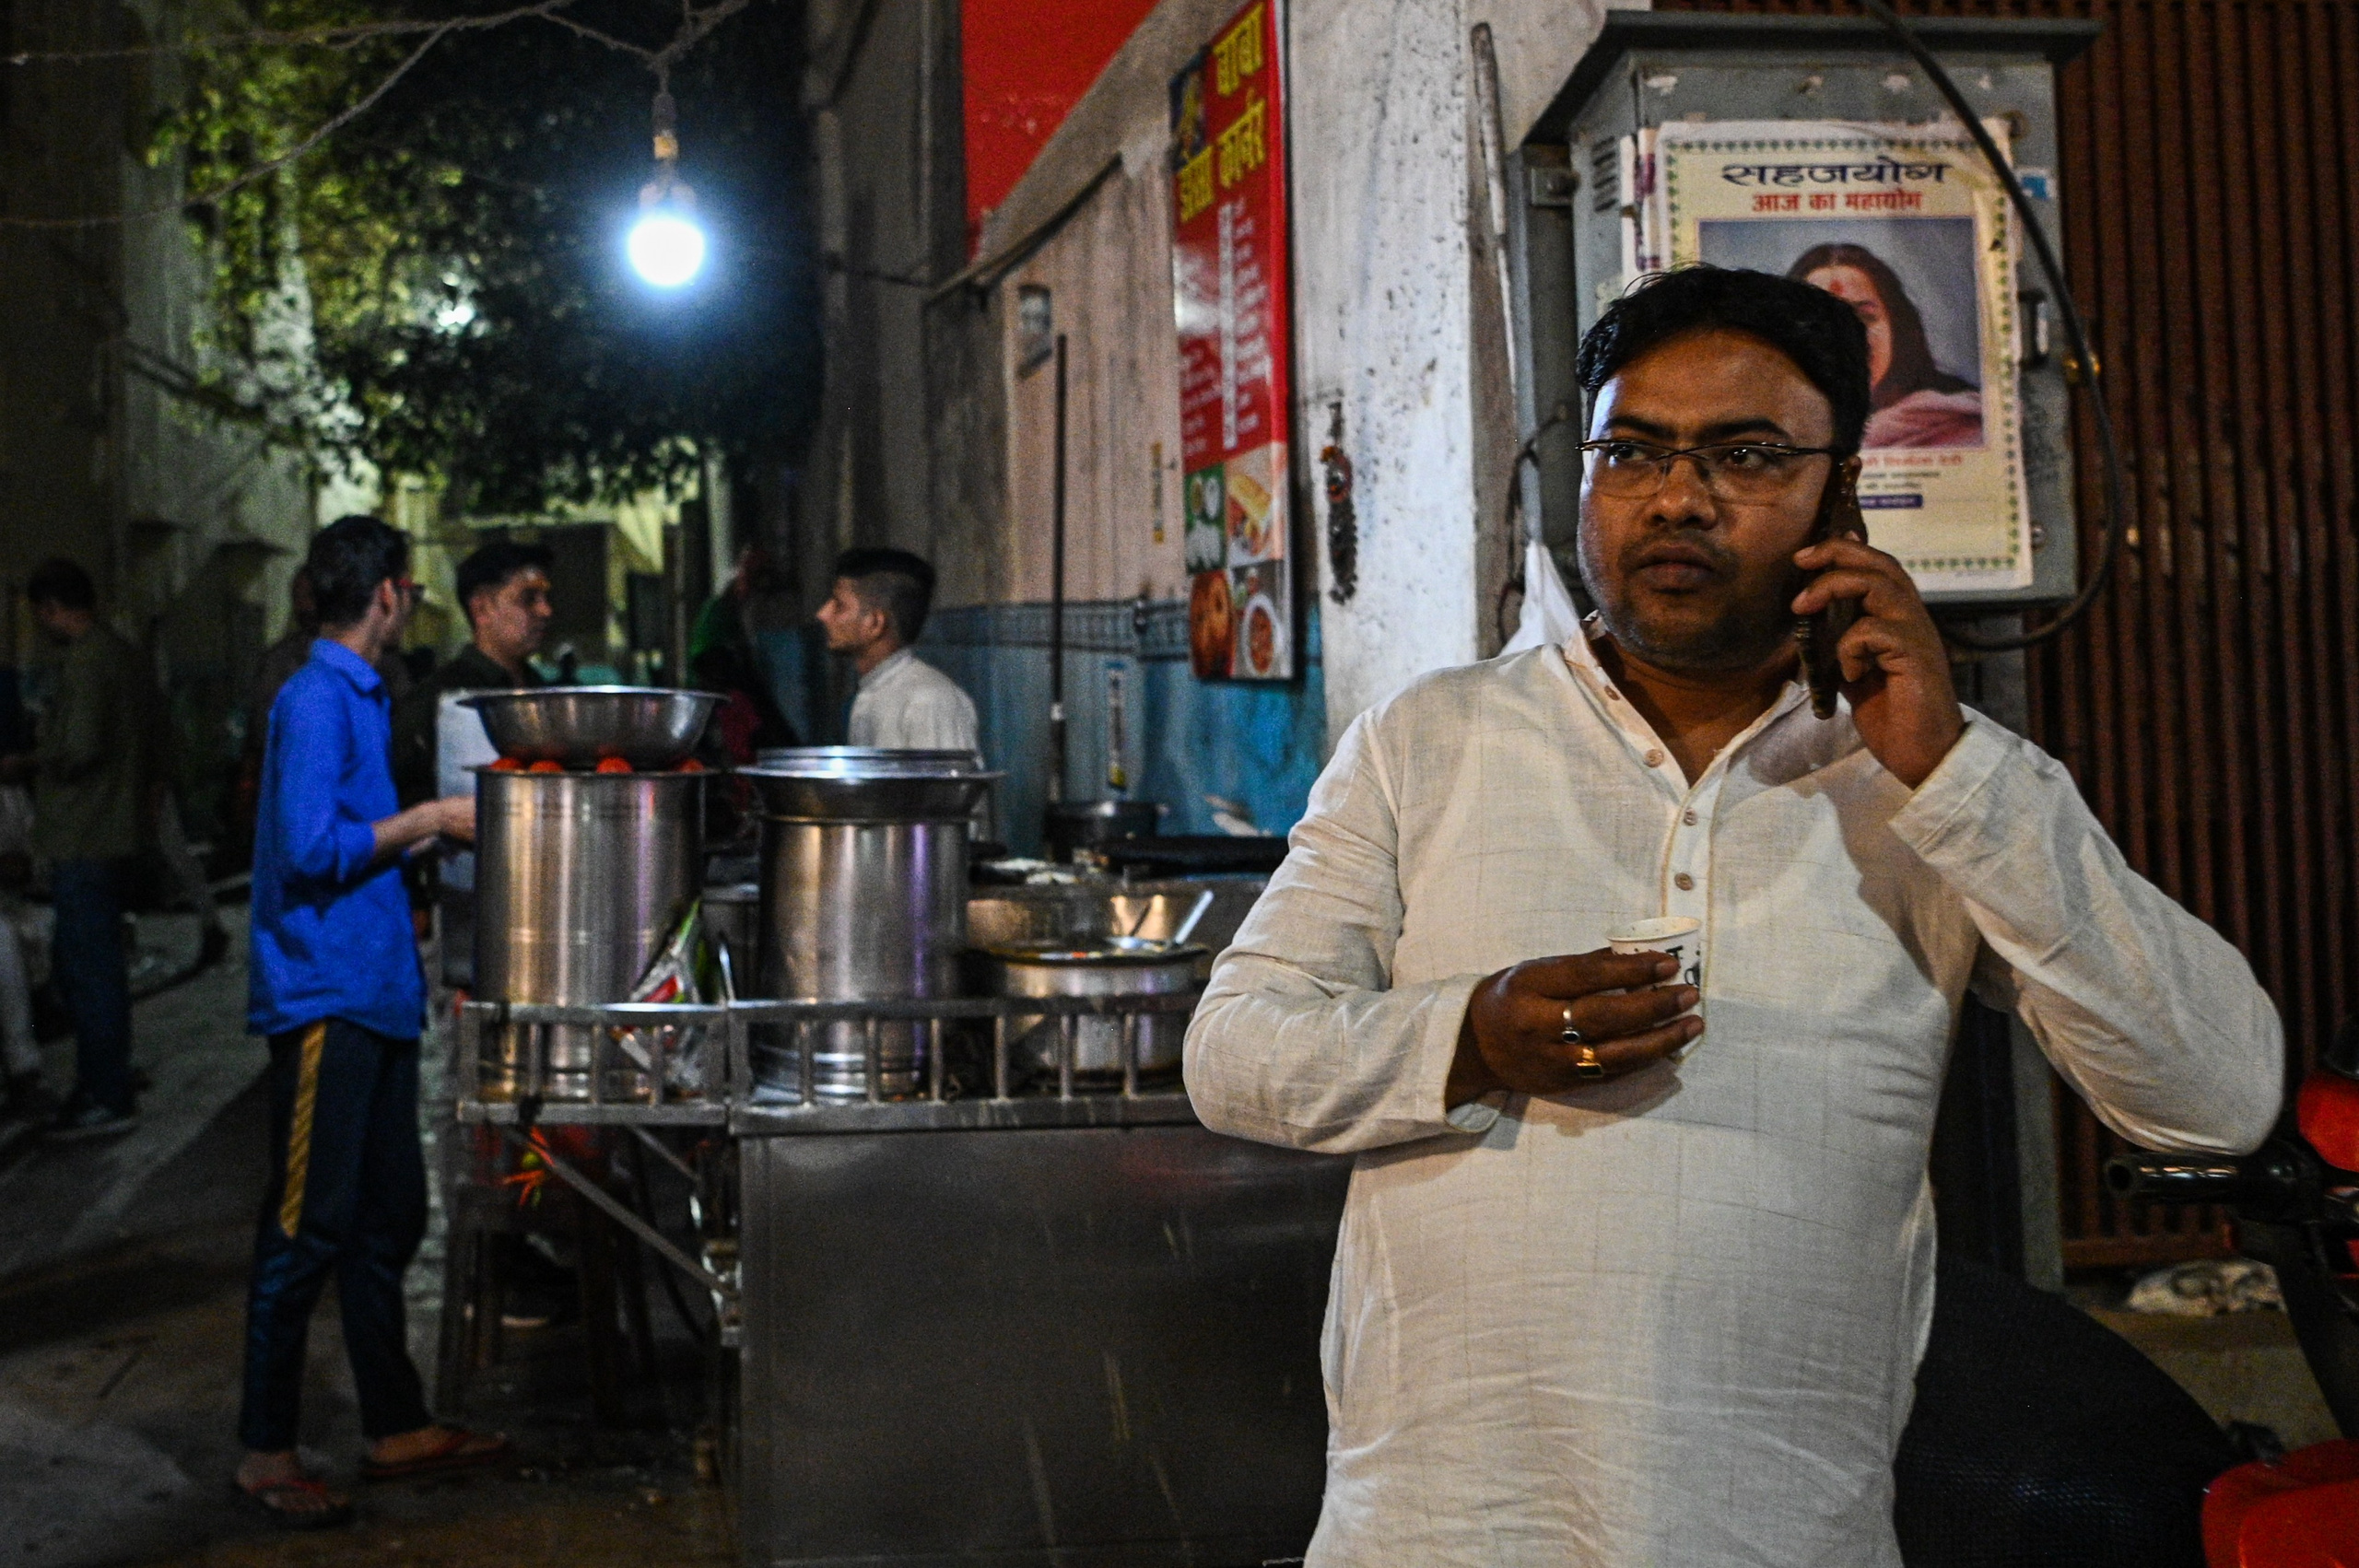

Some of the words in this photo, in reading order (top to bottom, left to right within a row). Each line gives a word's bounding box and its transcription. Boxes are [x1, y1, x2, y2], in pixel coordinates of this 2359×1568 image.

[1721, 155, 1952, 186] सहजयोग
[1753, 193, 1801, 212] आज
[1809, 193, 1837, 211] का
[1845, 188, 1922, 211] महायोग
